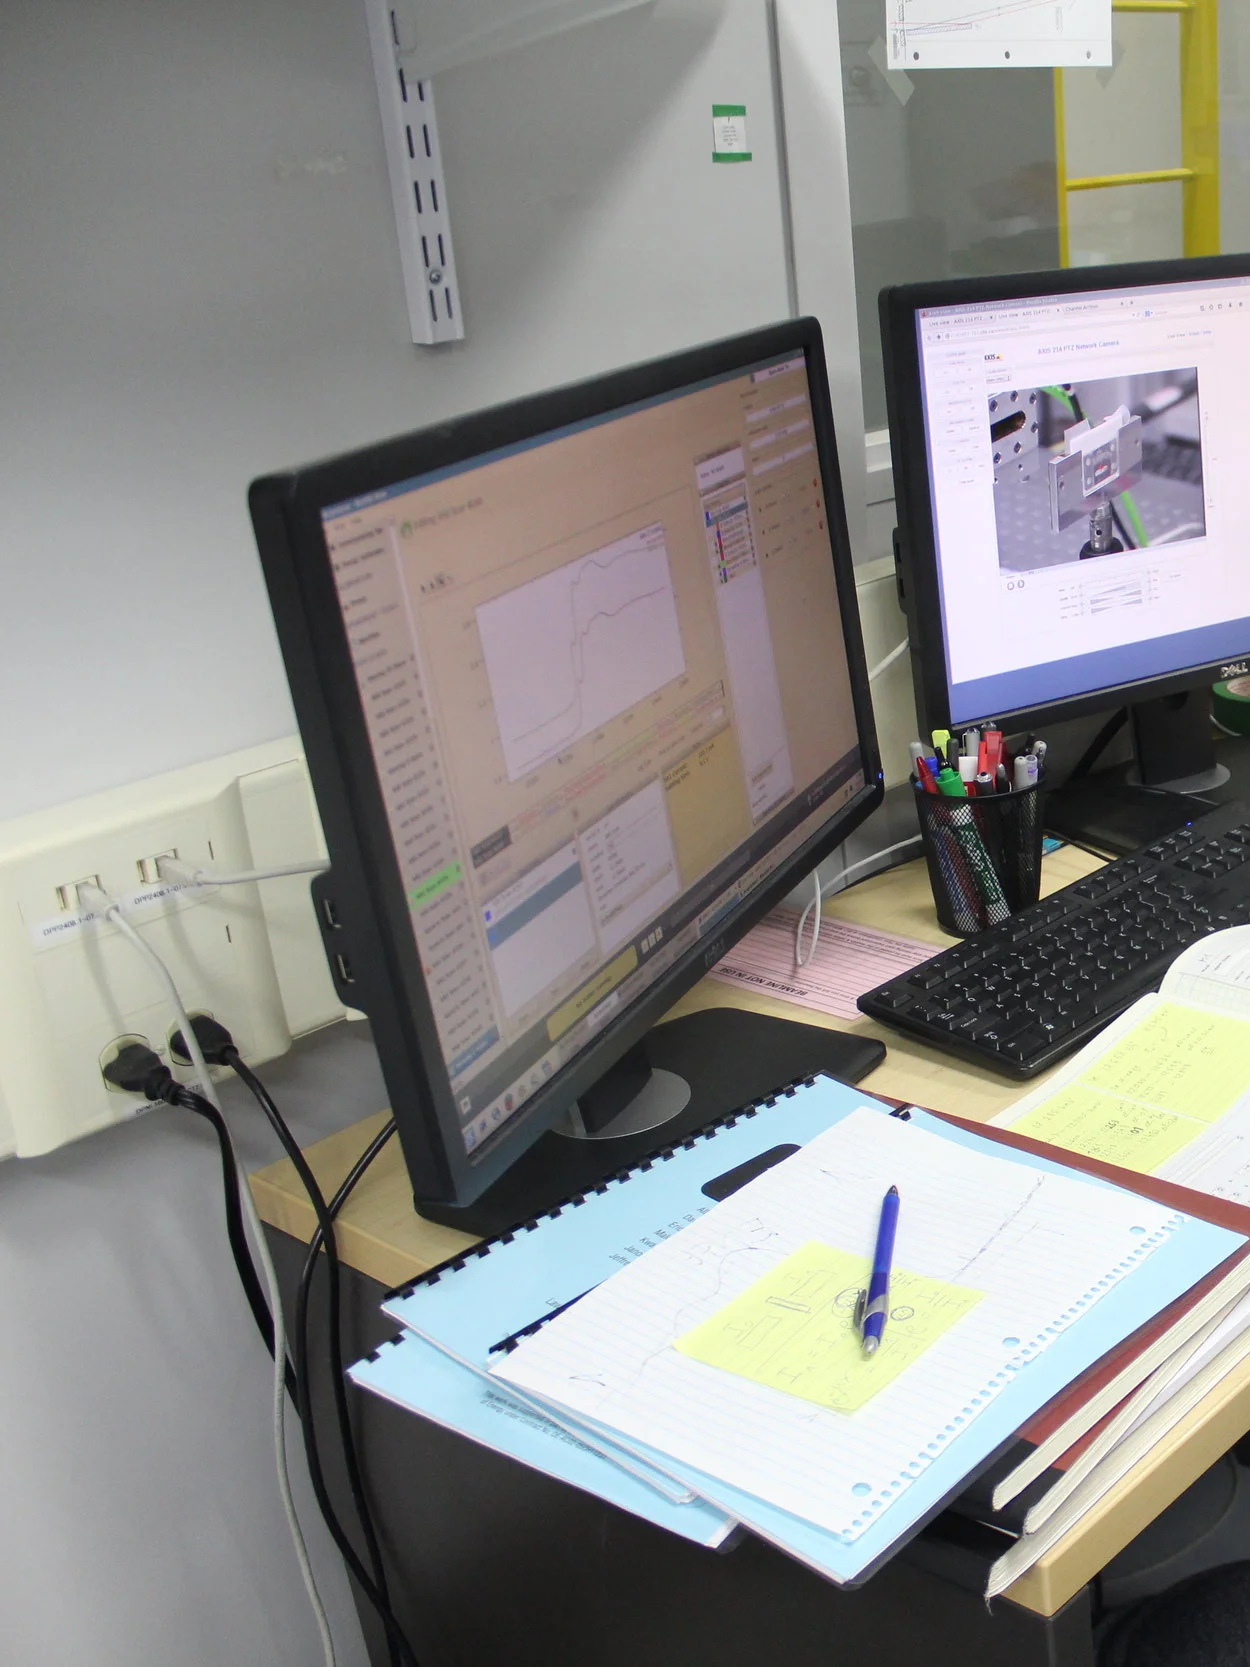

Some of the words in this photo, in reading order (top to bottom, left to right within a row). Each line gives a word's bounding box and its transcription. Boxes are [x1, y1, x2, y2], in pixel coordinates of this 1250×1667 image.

[1038, 347, 1051, 355] AXIS
[1075, 341, 1097, 351] Network
[1098, 339, 1120, 348] Camera
[1221, 662, 1248, 679] DELL
[719, 966, 736, 976] USE
[734, 970, 748, 979] IN
[746, 974, 766, 985] NOT
[764, 979, 808, 997] BEAMLINE
